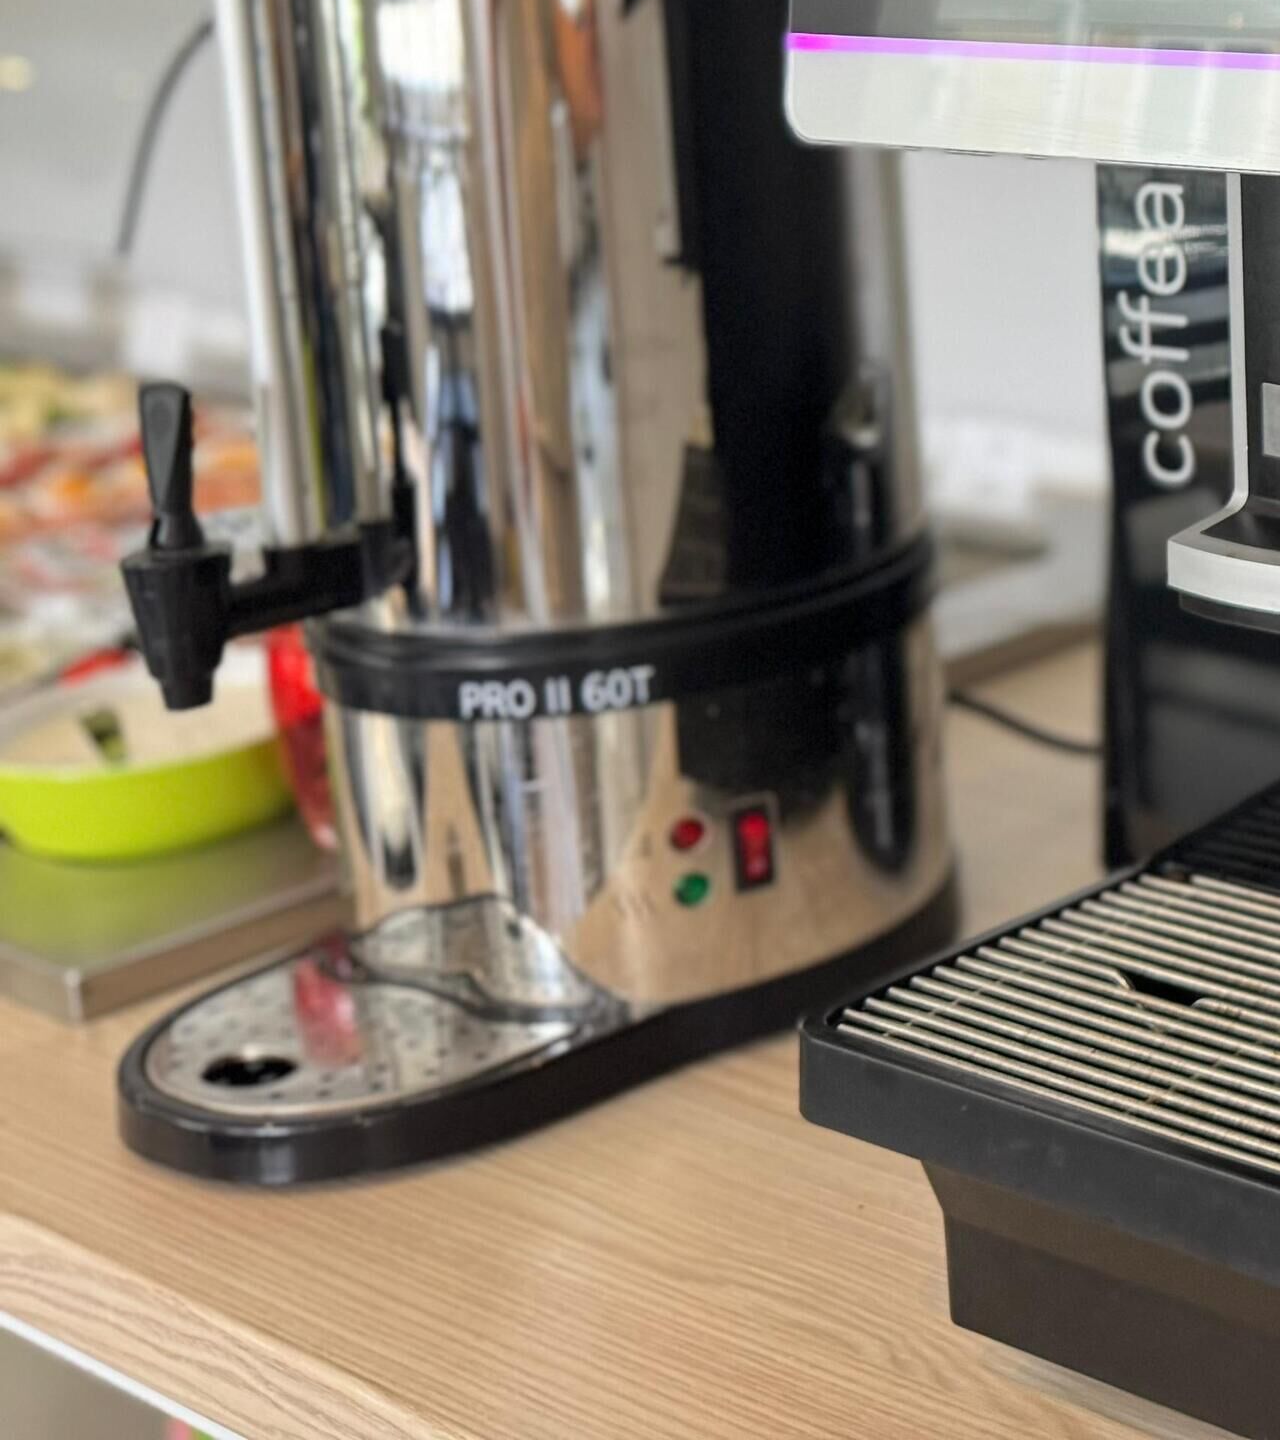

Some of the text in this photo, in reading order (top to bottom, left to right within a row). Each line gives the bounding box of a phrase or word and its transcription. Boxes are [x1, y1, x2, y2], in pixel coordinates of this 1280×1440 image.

[1117, 180, 1197, 489] coffea
[459, 678, 535, 719] PRO
[581, 664, 655, 711] 60T
